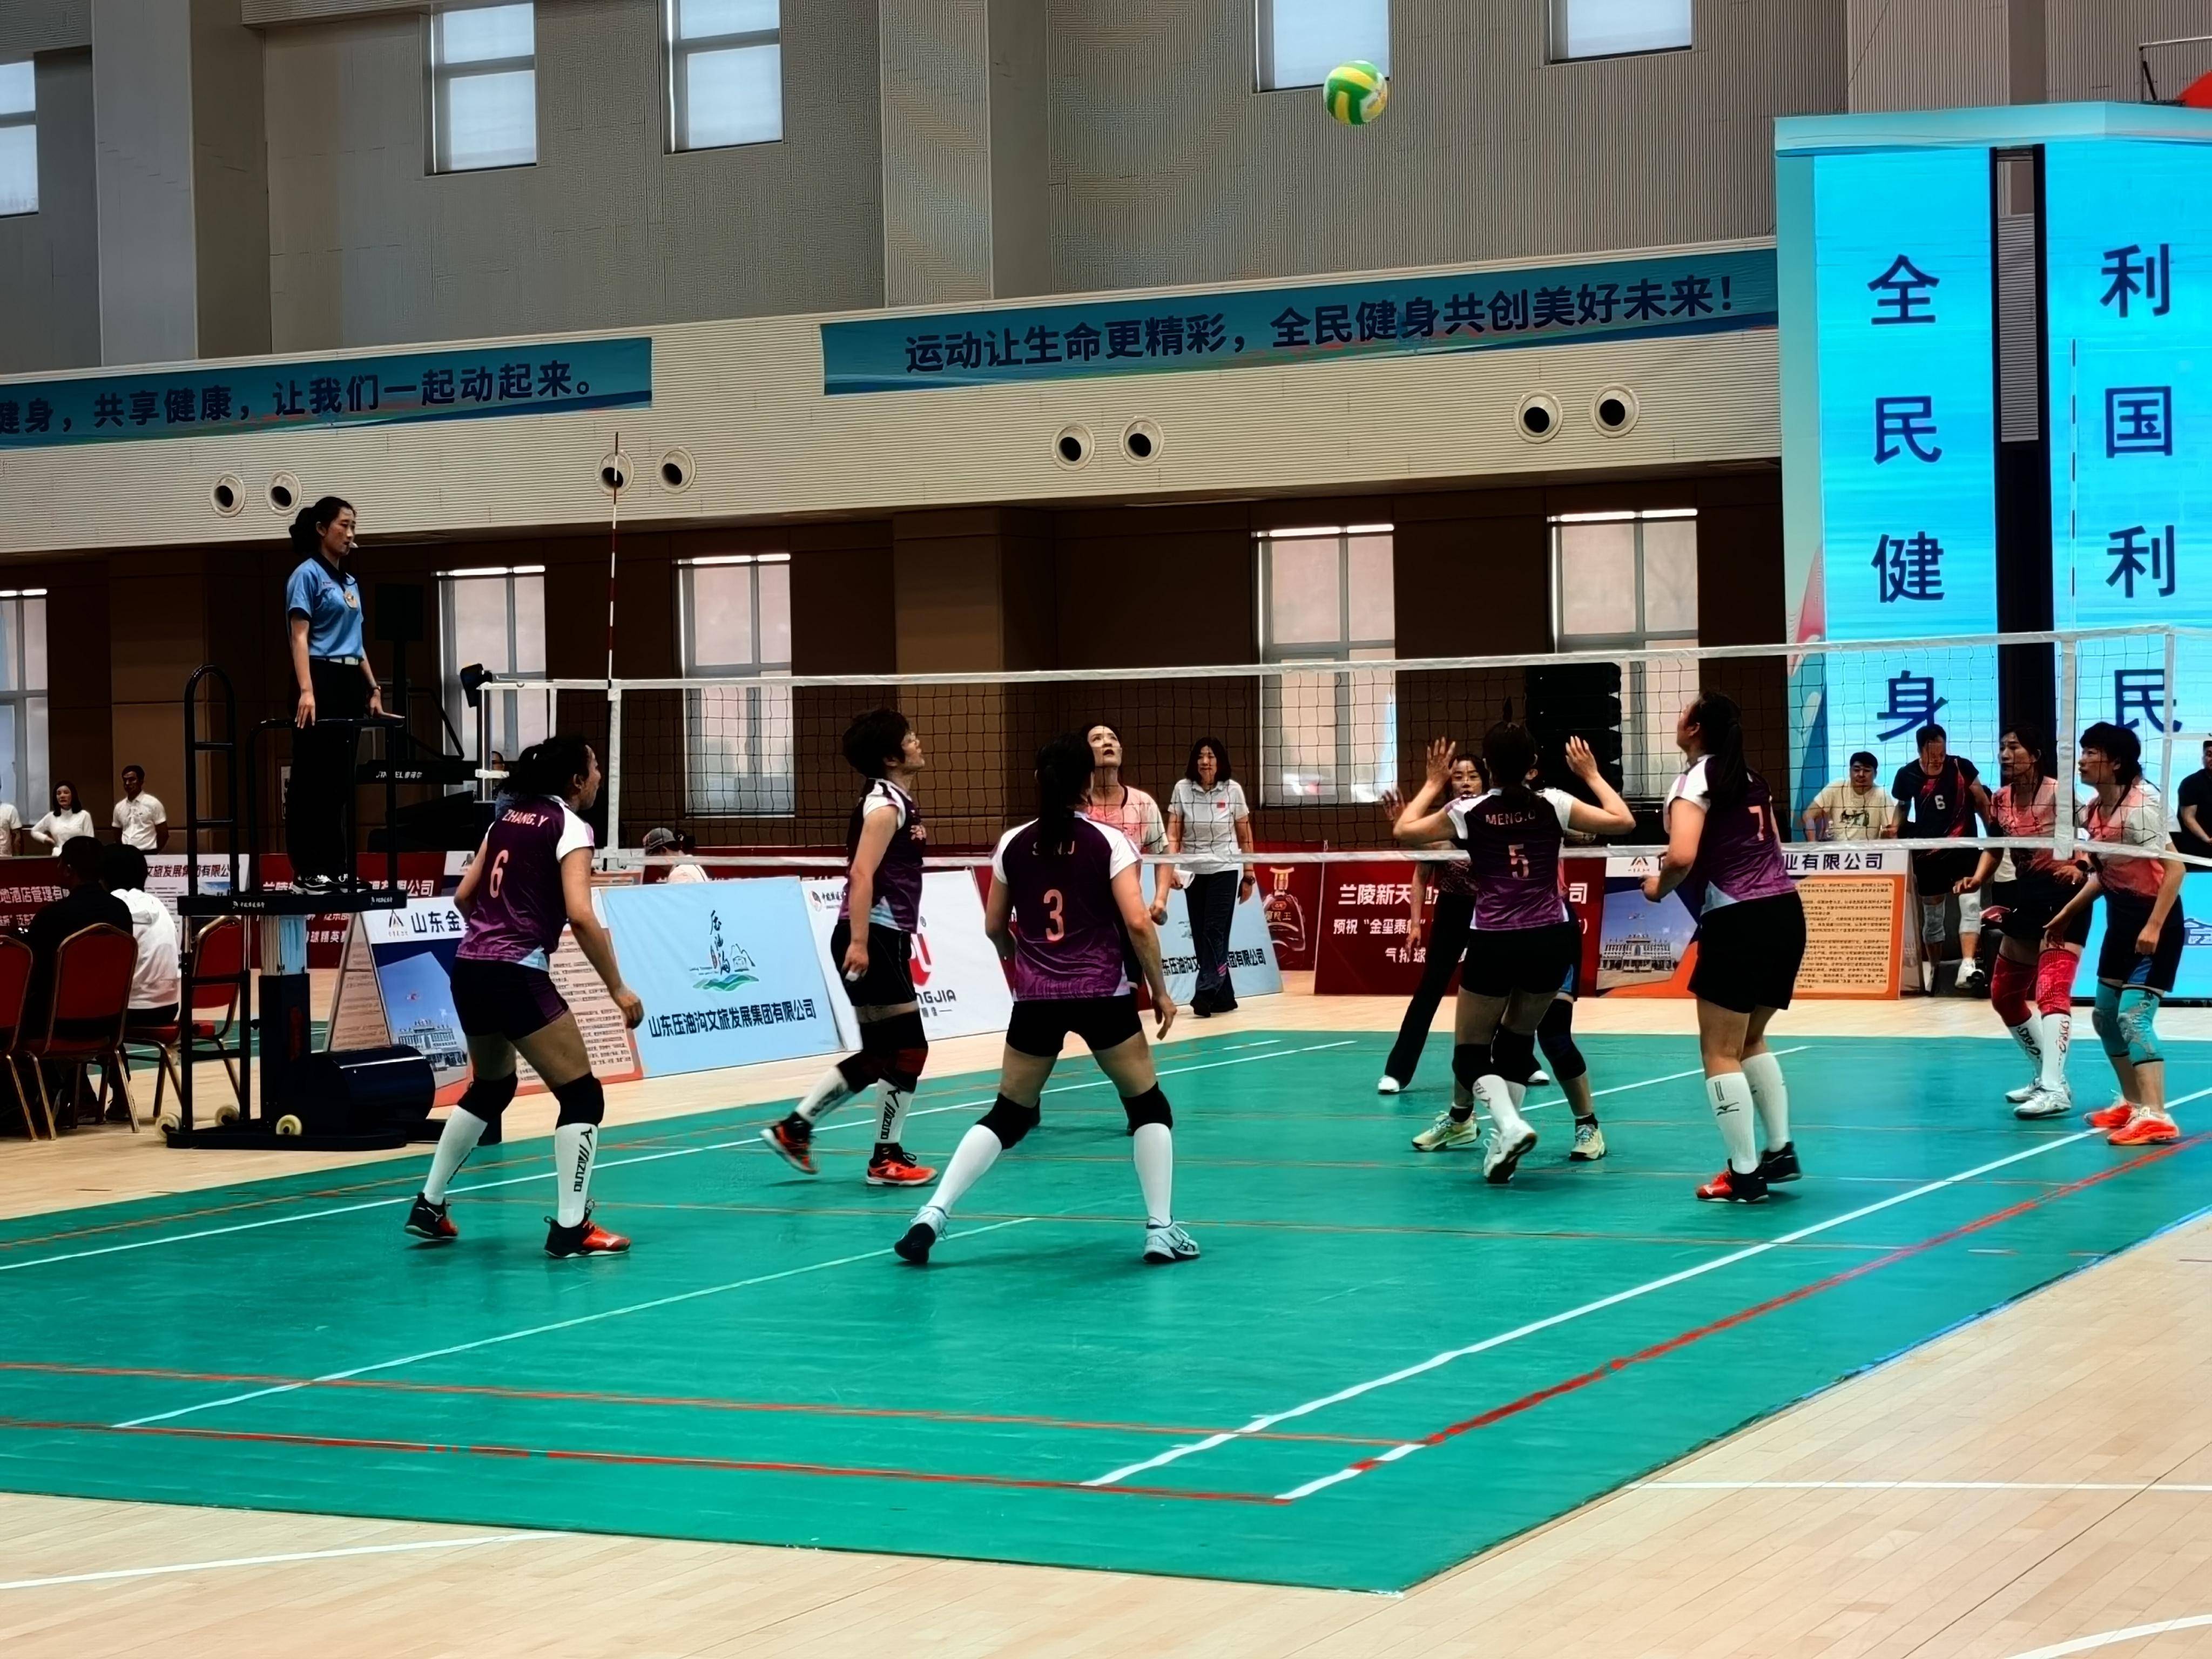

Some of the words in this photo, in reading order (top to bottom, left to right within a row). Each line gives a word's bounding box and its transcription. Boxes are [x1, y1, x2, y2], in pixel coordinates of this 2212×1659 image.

[904, 276, 1733, 374] 运动让生命更精彩，全民健身共创美好未来！
[1867, 254, 1949, 741] 全民健身
[2100, 244, 2183, 734] 利国利民
[1748, 806, 1764, 841] 7
[1935, 795, 1946, 810] 6
[490, 849, 509, 898] 6
[1508, 844, 1529, 879] 5
[410, 911, 470, 933] 山东金
[1043, 889, 1064, 941] 3
[648, 998, 817, 1038] 山东压油沟文旅发展集团有限公司
